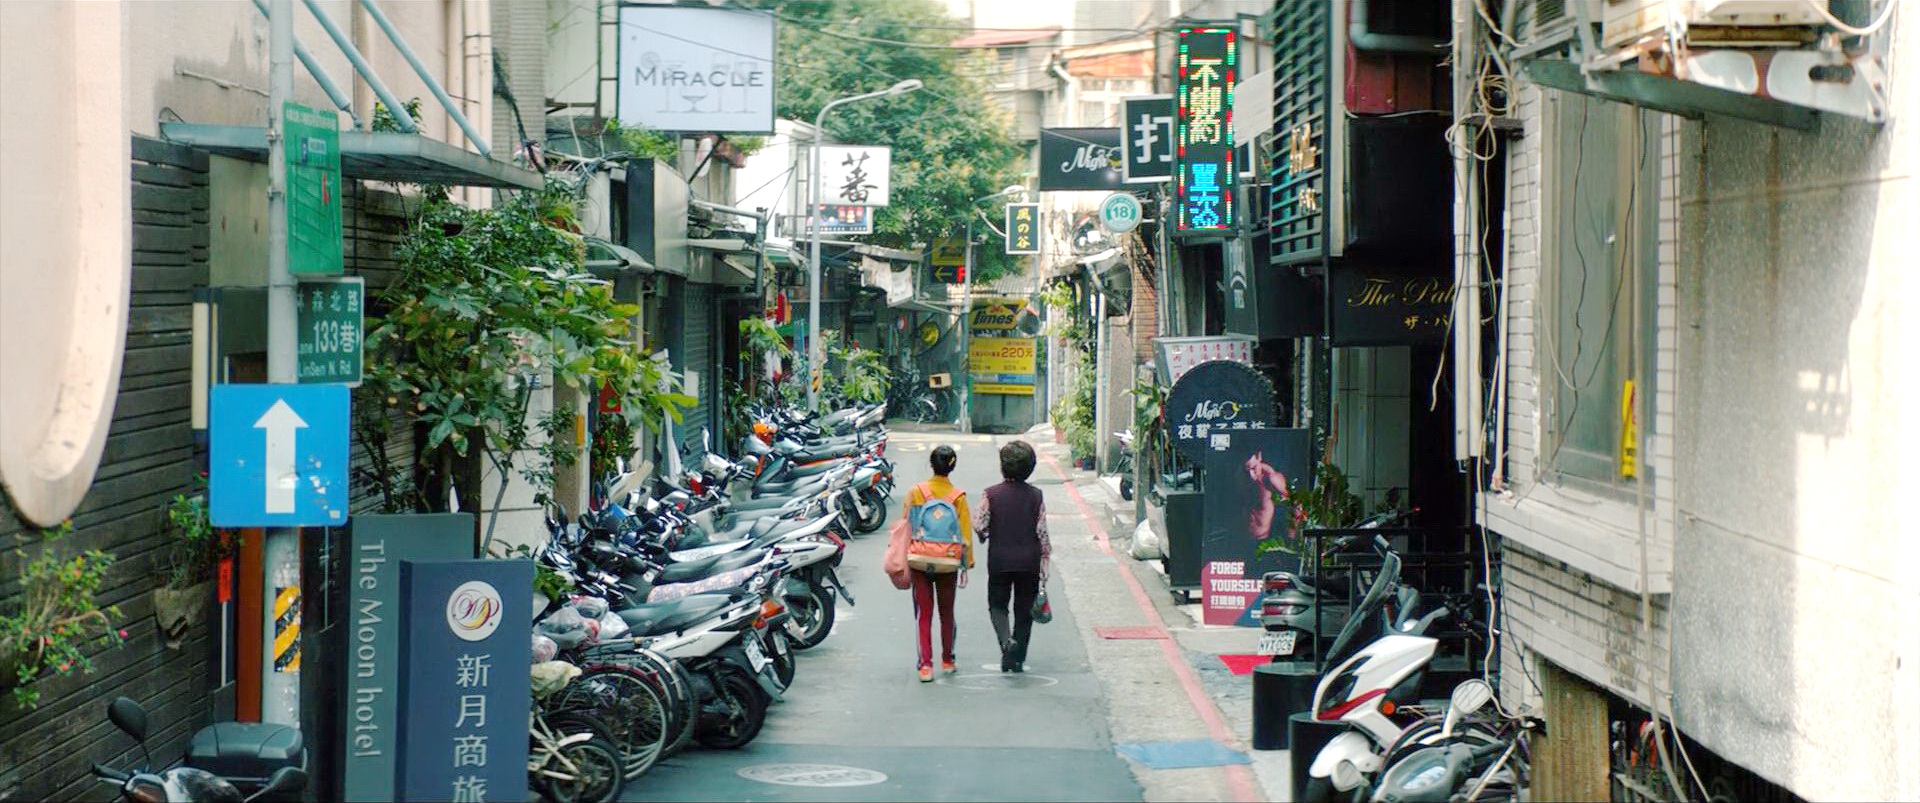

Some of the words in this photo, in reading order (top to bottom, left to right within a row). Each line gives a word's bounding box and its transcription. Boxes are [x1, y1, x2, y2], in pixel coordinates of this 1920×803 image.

[635, 66, 764, 87] MIRACLE
[1016, 206, 1031, 250] 風の谷
[1113, 206, 1129, 218] 18
[1347, 278, 1395, 306] The
[1403, 277, 1455, 306] Pal
[300, 343, 313, 355] ane
[313, 320, 355, 353] 133巷
[359, 539, 386, 590] The
[1210, 561, 1245, 575] FORGE
[1210, 579, 1263, 592] YOURSELF
[358, 598, 383, 678] Moon
[355, 687, 383, 757] hotel
[452, 654, 492, 802] 新月商旅
